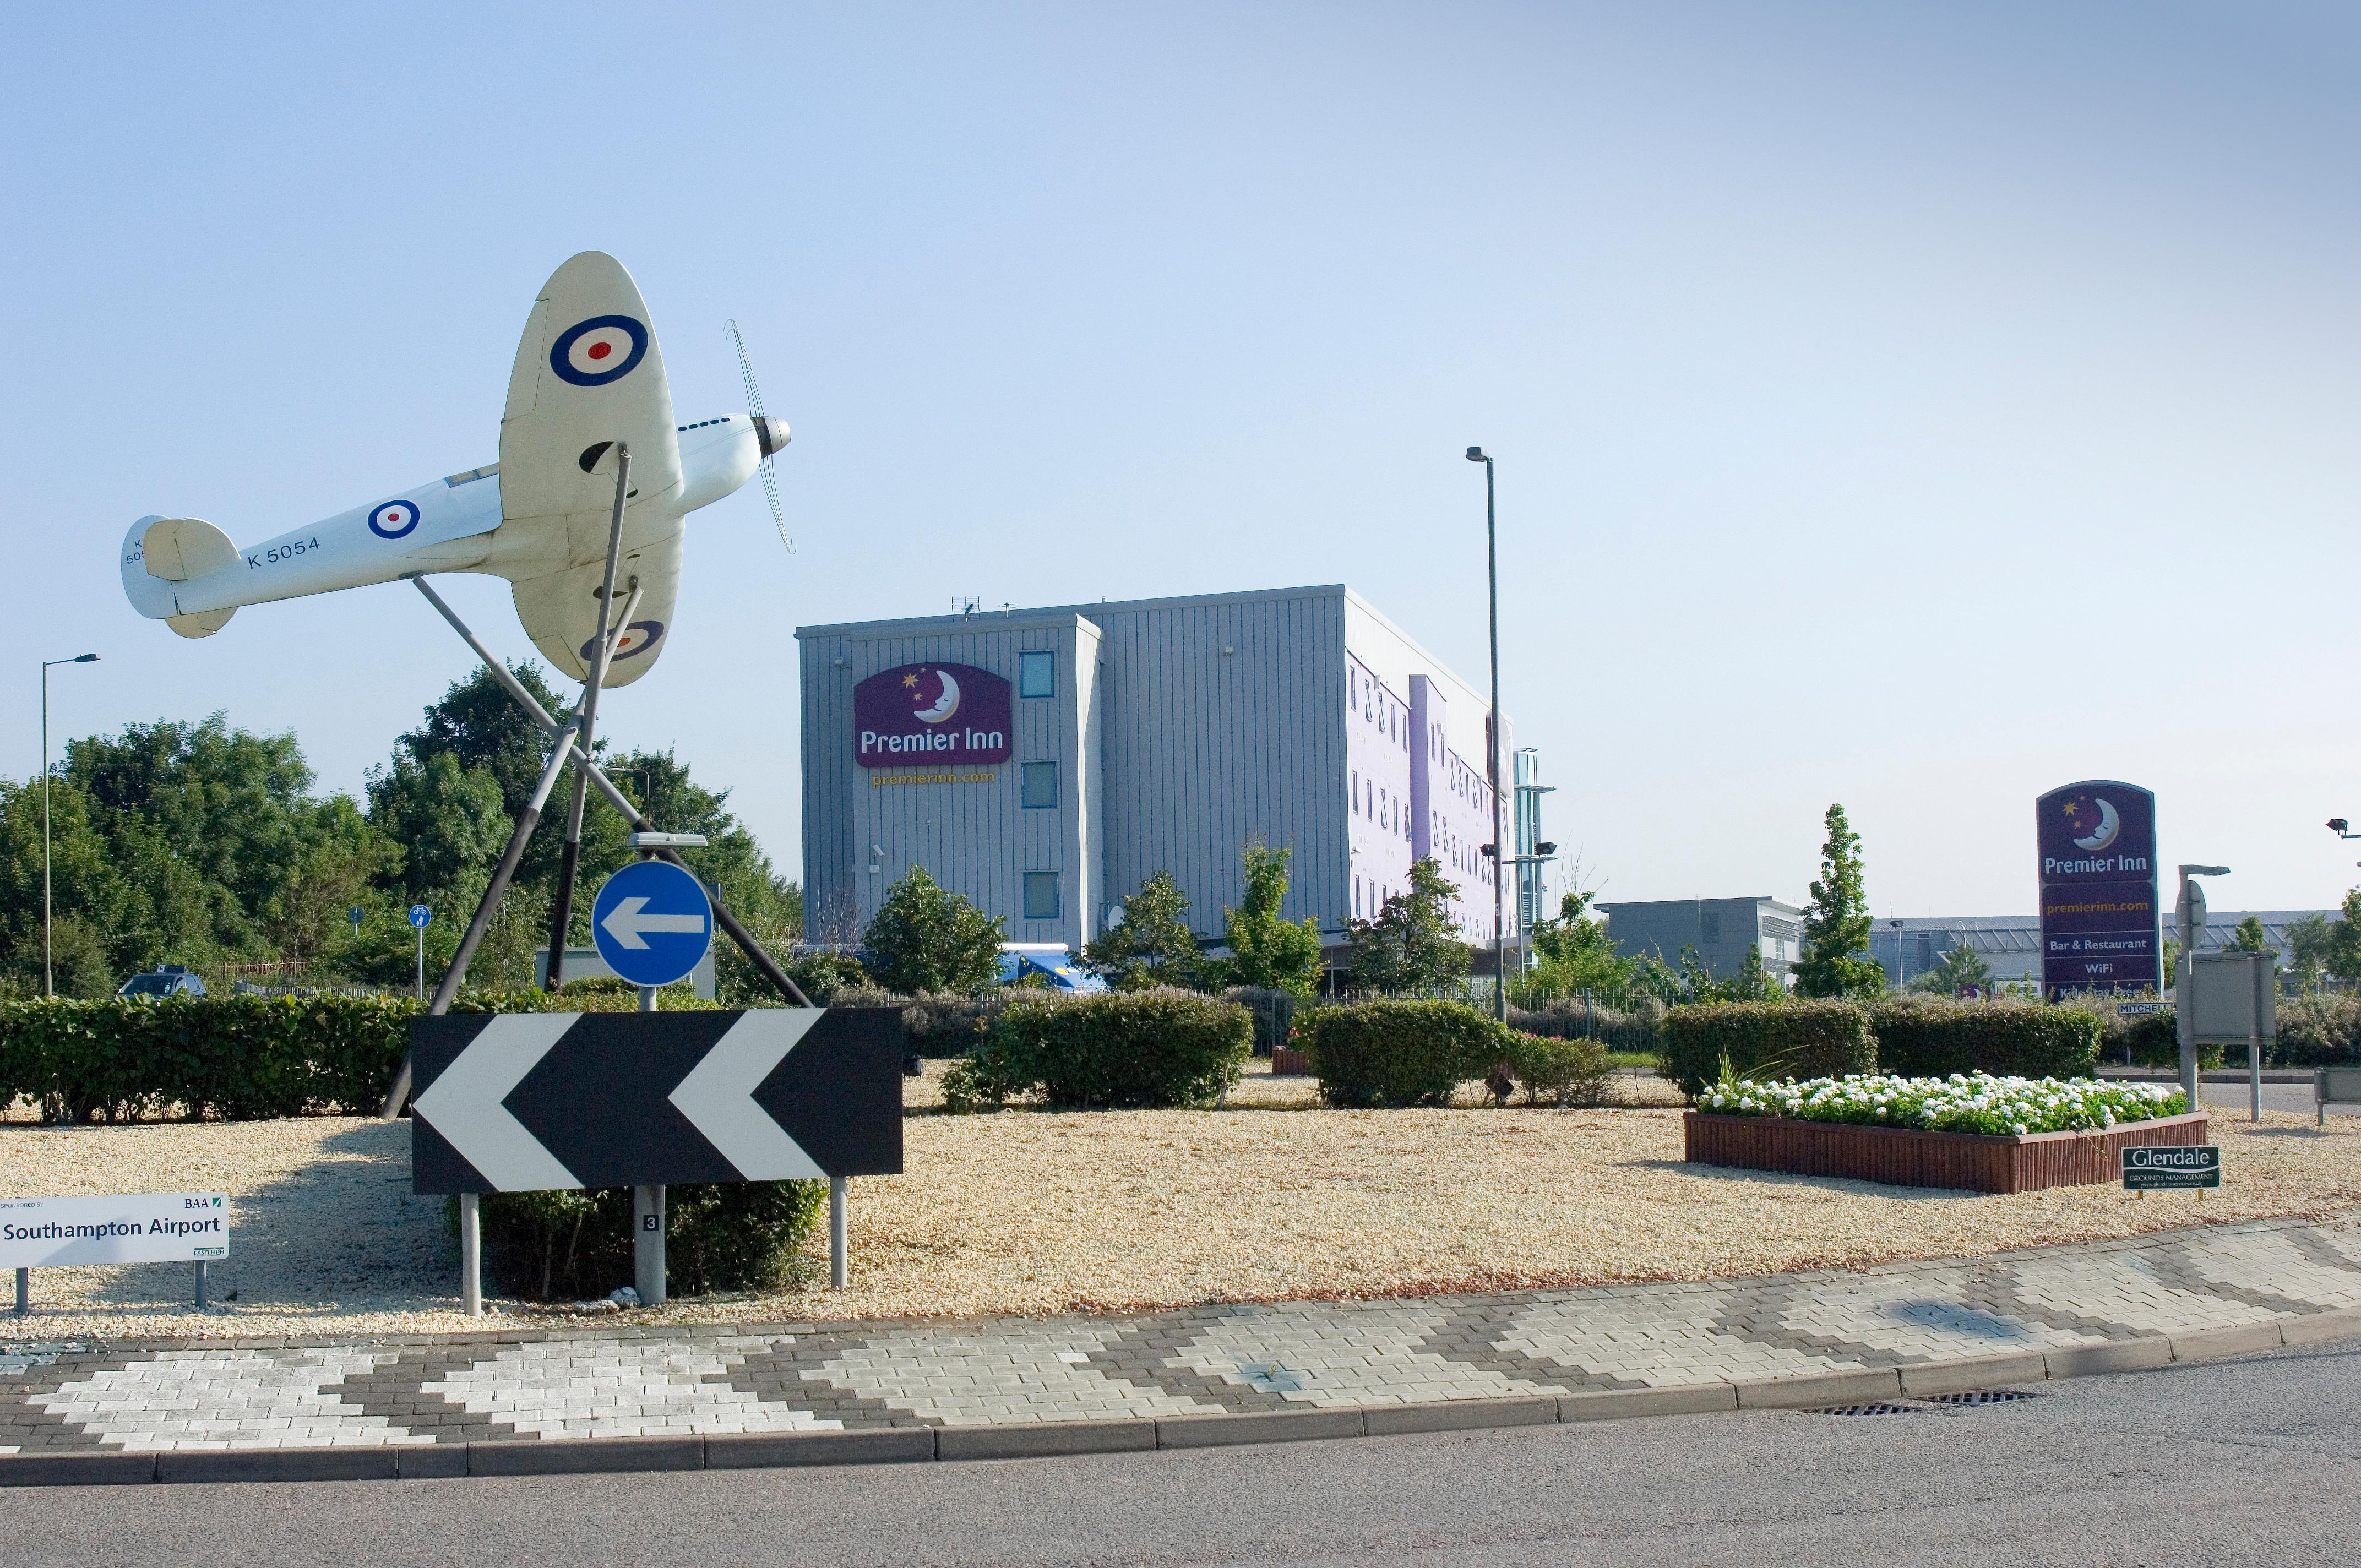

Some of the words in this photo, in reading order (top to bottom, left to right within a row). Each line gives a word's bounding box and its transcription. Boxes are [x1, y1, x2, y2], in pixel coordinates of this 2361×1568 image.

[134, 540, 142, 548] K
[248, 554, 262, 569] K
[268, 537, 320, 563] 5054
[862, 728, 959, 753] Premier
[965, 727, 1002, 749] Inn
[873, 772, 994, 788] premierinn.com
[2045, 856, 2114, 874] Premier
[2119, 855, 2146, 870] Inn
[2047, 901, 2148, 916] premierinn.com
[2050, 941, 2069, 950] Bar
[2072, 940, 2080, 949] &
[2084, 939, 2147, 949] Restaurant
[2085, 964, 2112, 973] WiFi
[2132, 1148, 2209, 1166] Glendale
[185, 1198, 209, 1208] BAA
[4, 1222, 141, 1240] Southampton
[149, 1218, 220, 1237] Airport
[647, 1217, 656, 1229] 3
